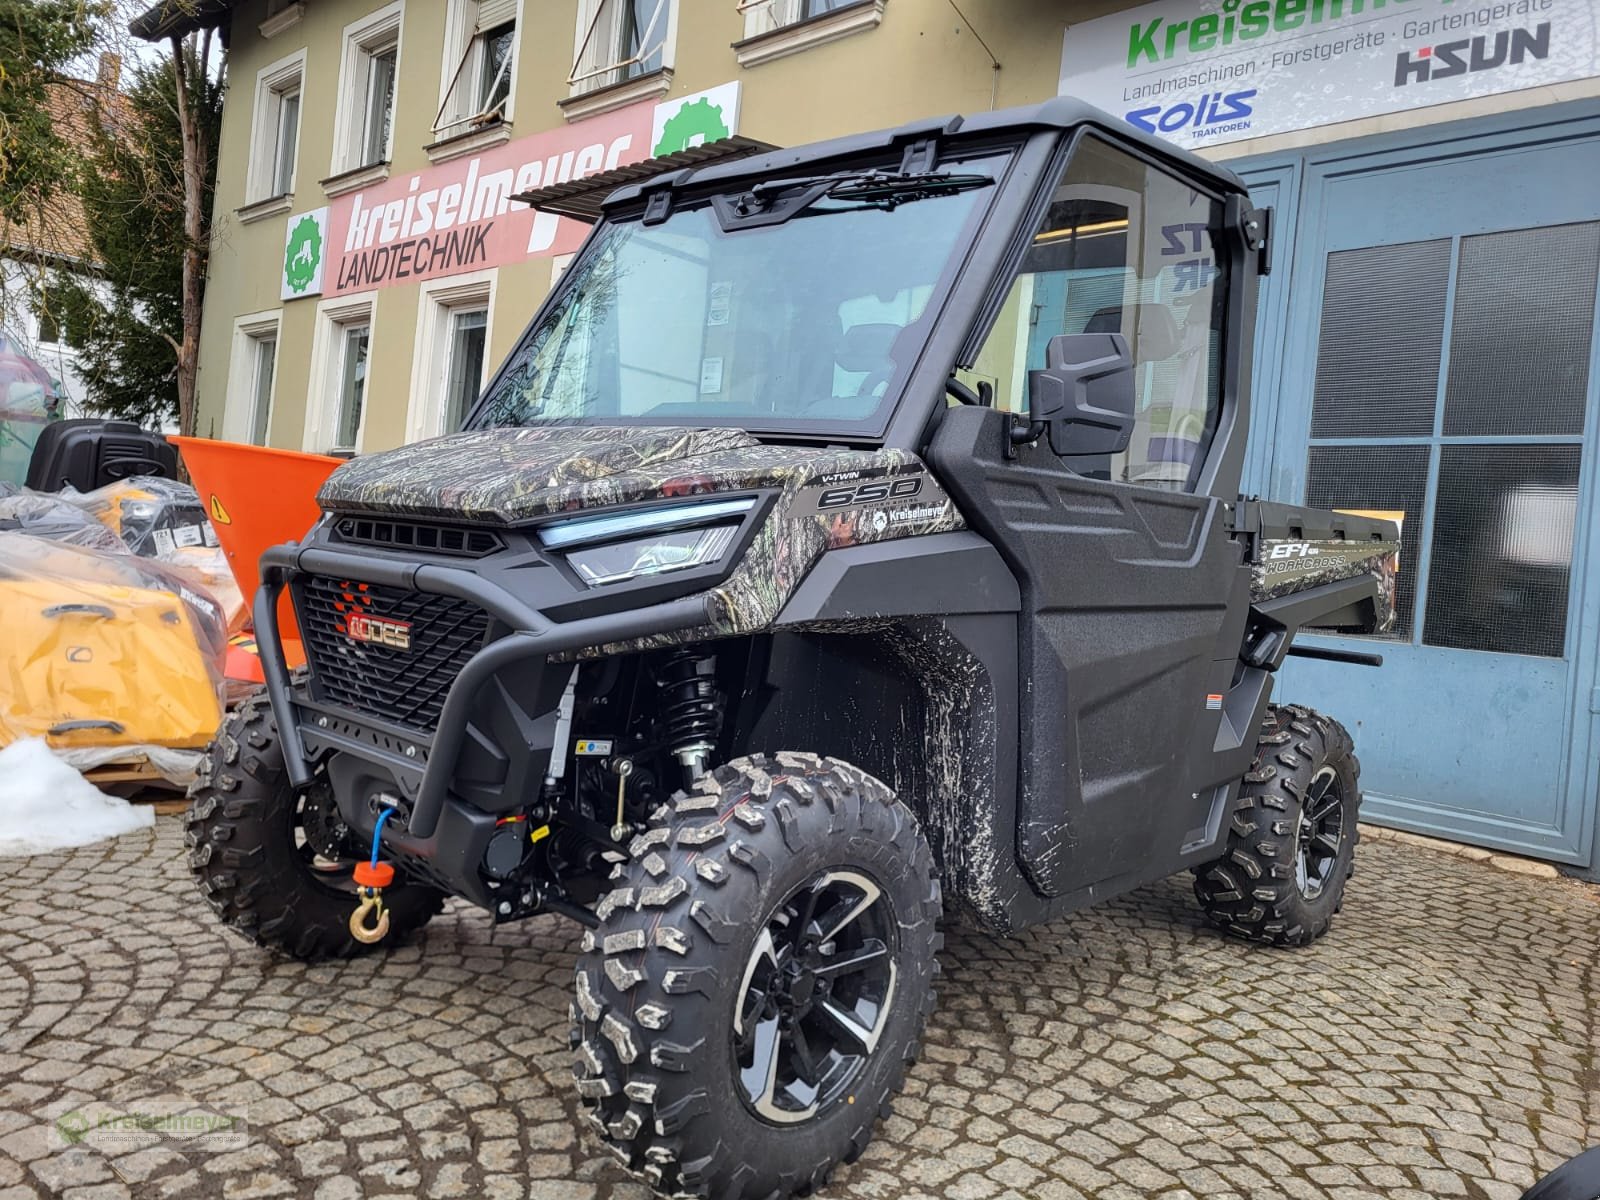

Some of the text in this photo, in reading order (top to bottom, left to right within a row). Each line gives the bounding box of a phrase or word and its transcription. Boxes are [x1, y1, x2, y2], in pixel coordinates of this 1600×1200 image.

[1123, 58, 1256, 102] Landmaschinen
[1271, 30, 1386, 69] Forstgeräte
[1191, 120, 1251, 139] TRAKTOREN
[336, 221, 494, 290] LANDTECHNIK
[822, 471, 860, 483] V-TWIN
[817, 476, 923, 509] 650
[1270, 543, 1309, 559] EFI
